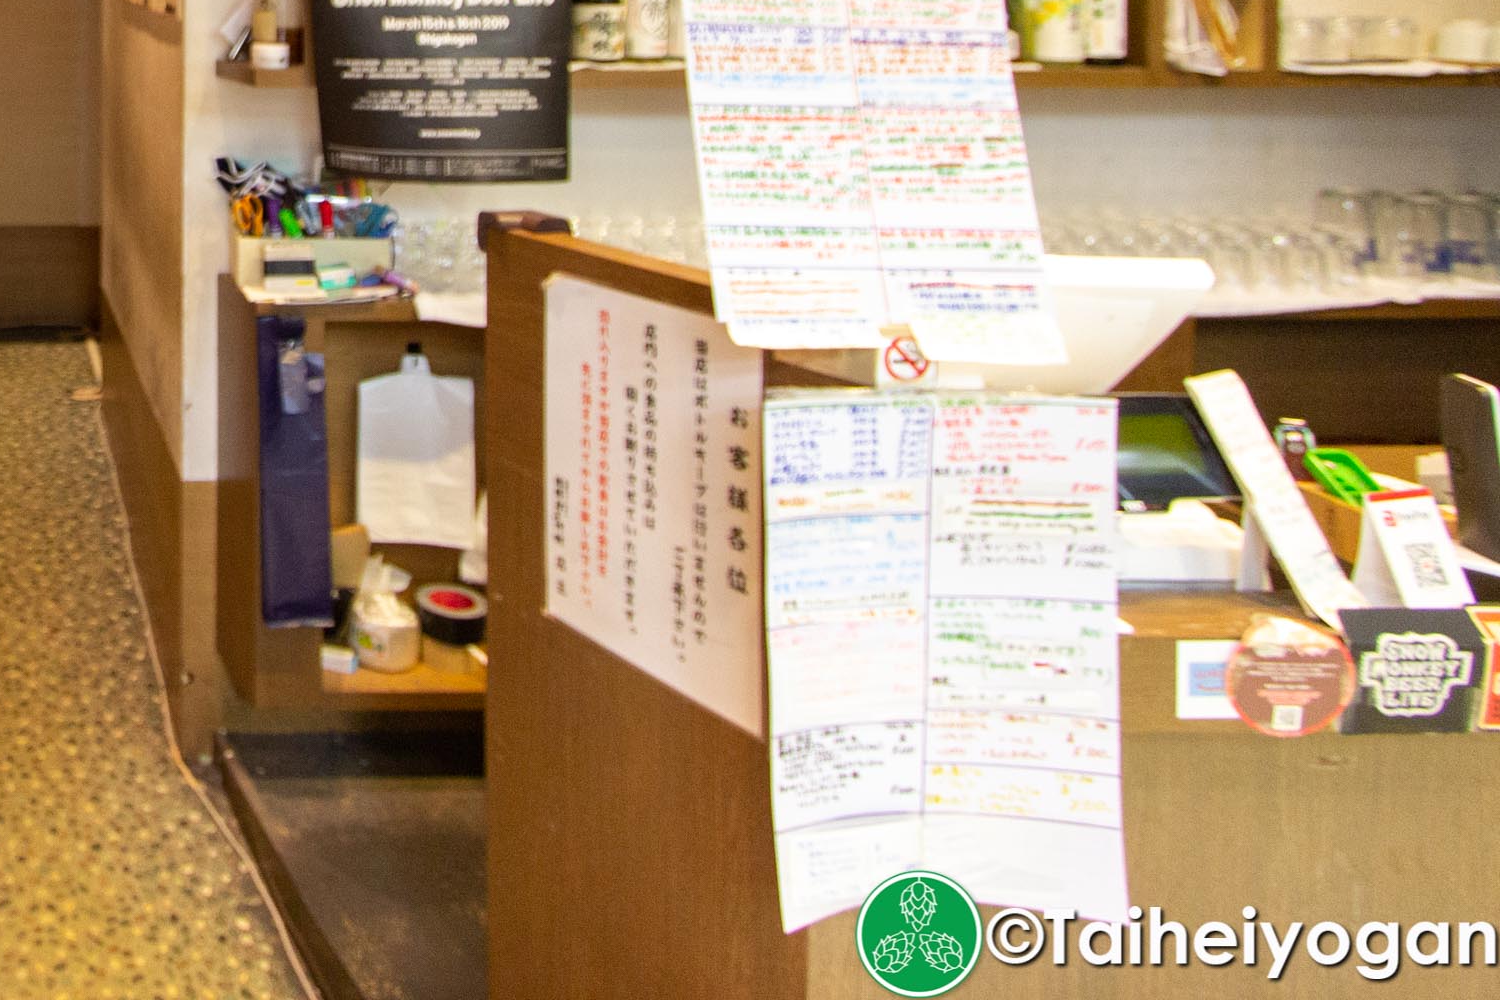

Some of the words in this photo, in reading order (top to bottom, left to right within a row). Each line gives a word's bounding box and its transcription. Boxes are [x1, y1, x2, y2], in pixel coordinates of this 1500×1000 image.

[727, 405, 749, 595] お客様各位
[1384, 641, 1447, 660] SNOW
